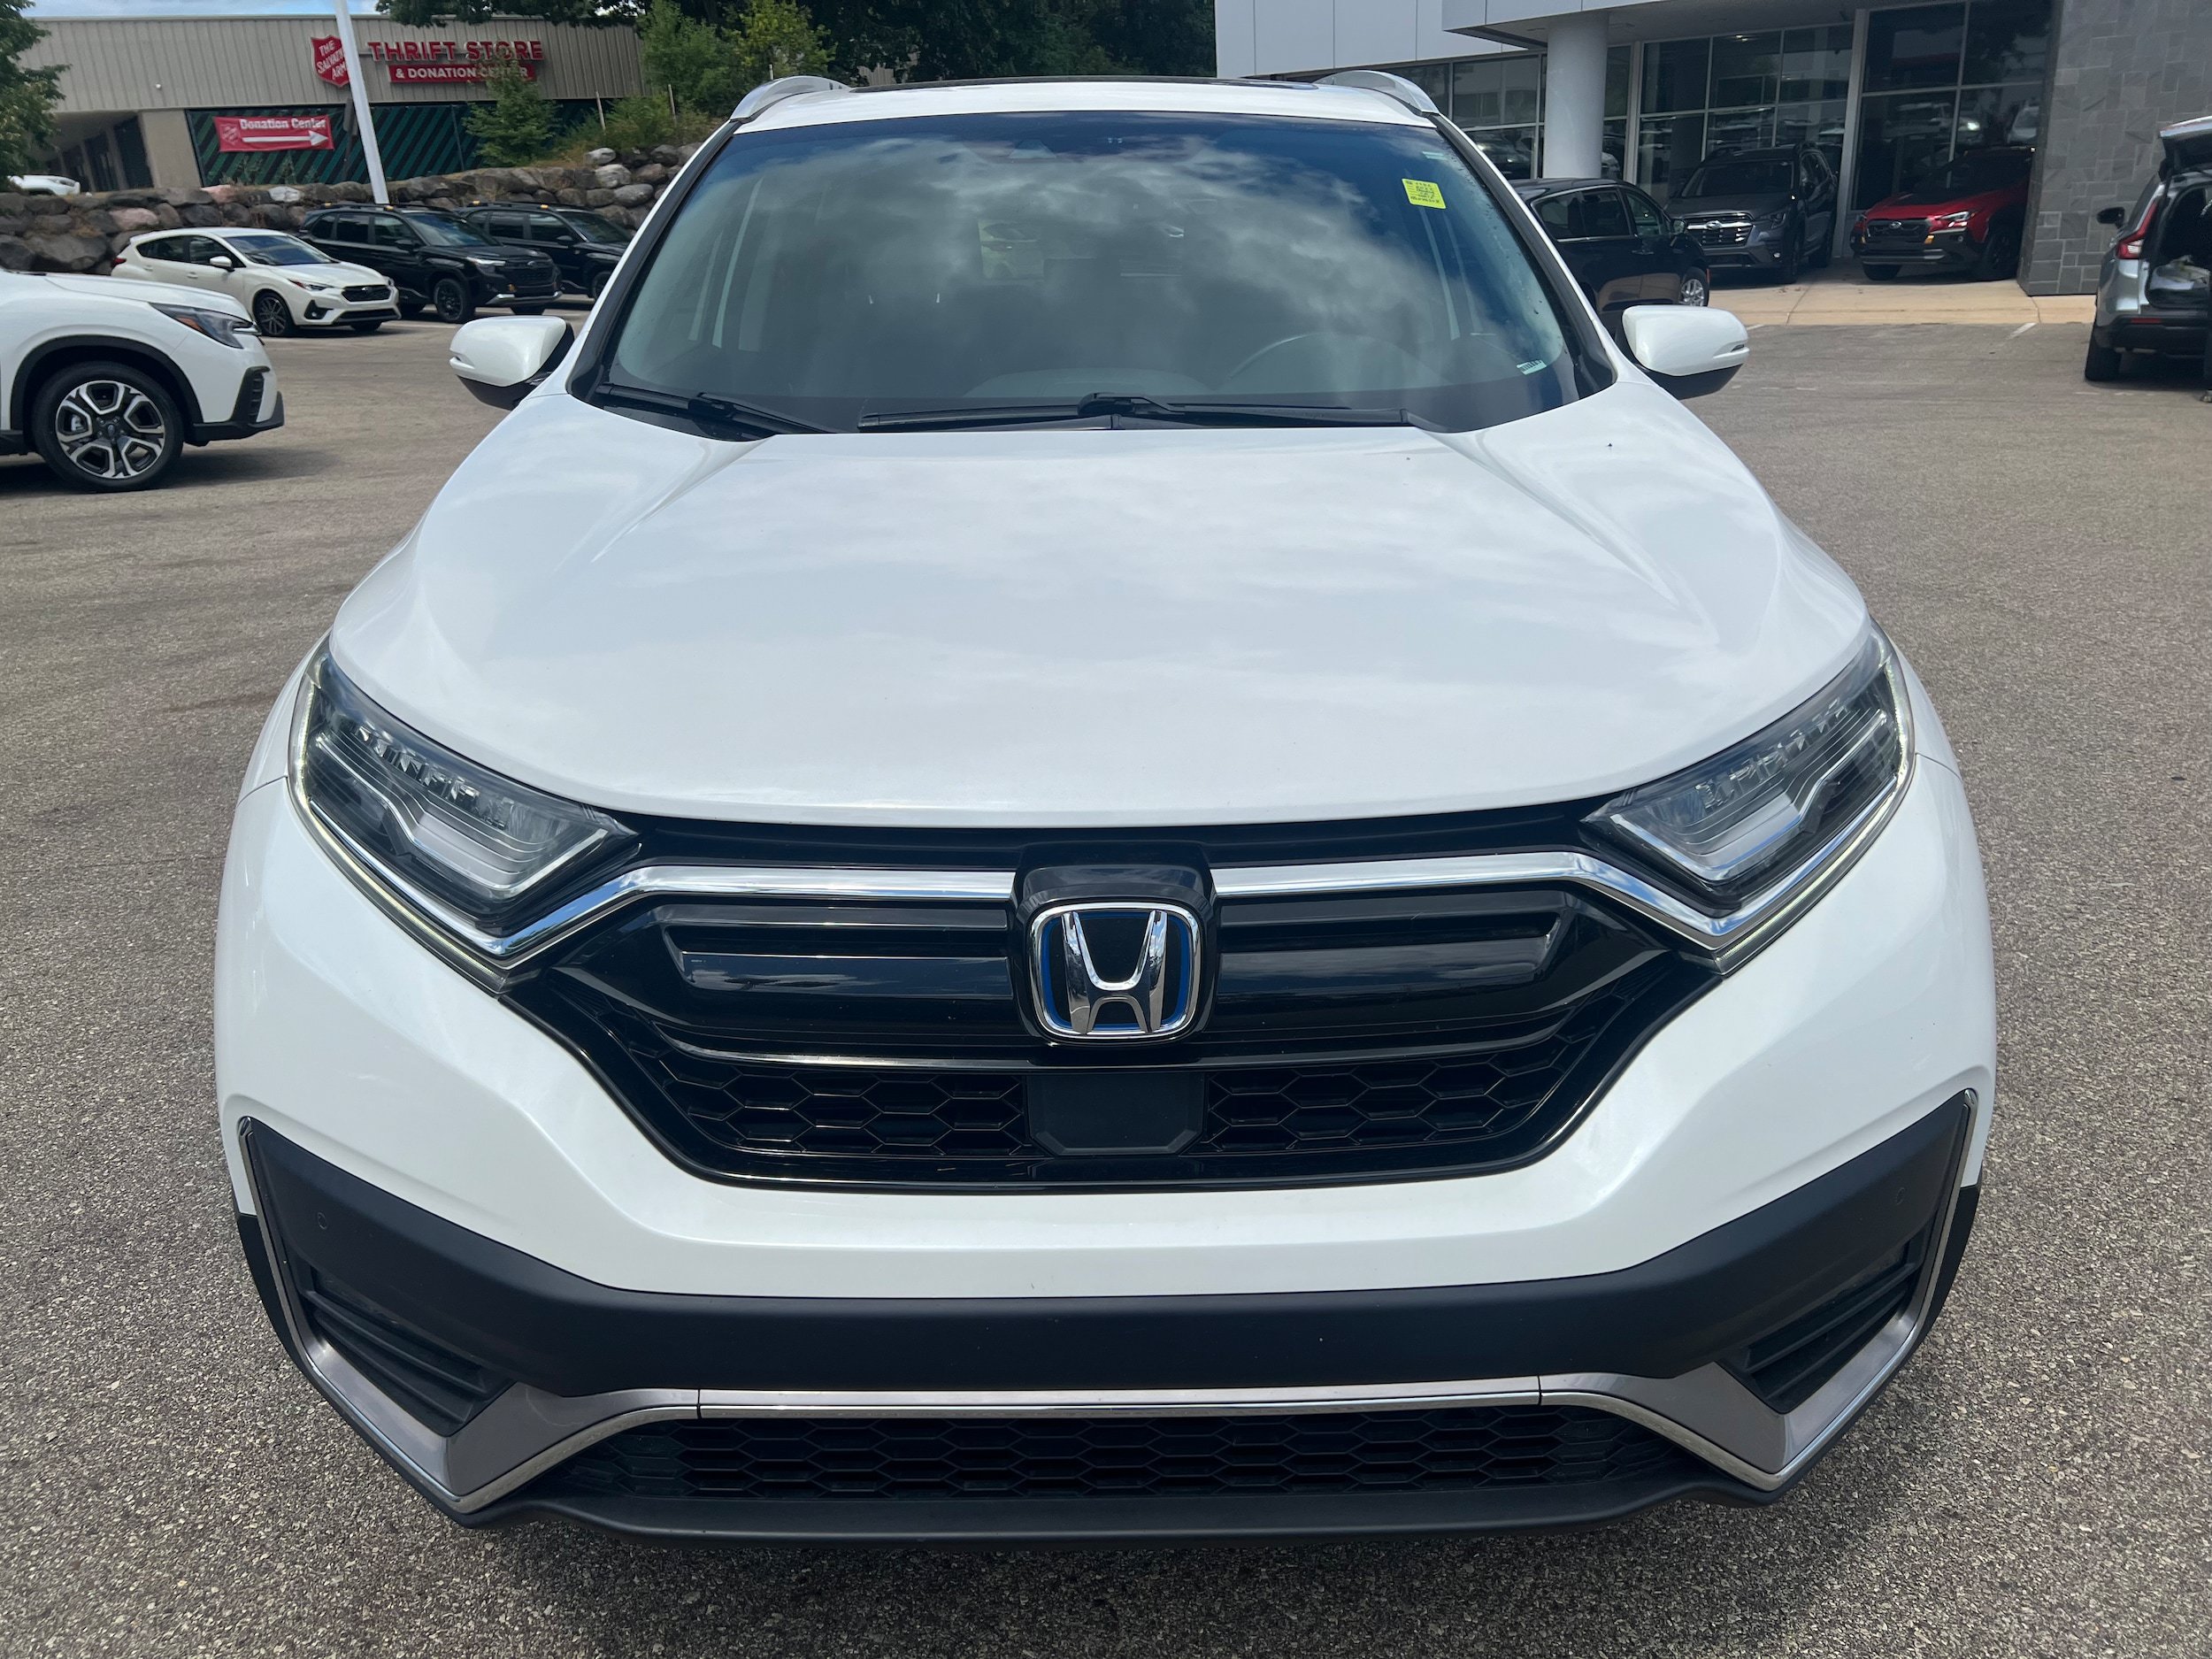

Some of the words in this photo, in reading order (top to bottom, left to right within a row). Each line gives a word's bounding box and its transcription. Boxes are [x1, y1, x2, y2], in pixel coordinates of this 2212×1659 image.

[319, 40, 335, 57] THE
[367, 41, 457, 61] THRIFT
[465, 41, 545, 61] STORE
[332, 61, 347, 81] ARM
[396, 67, 405, 79] &
[408, 67, 477, 79] DONATION
[240, 119, 289, 130] Donation
[291, 118, 326, 129] Center
